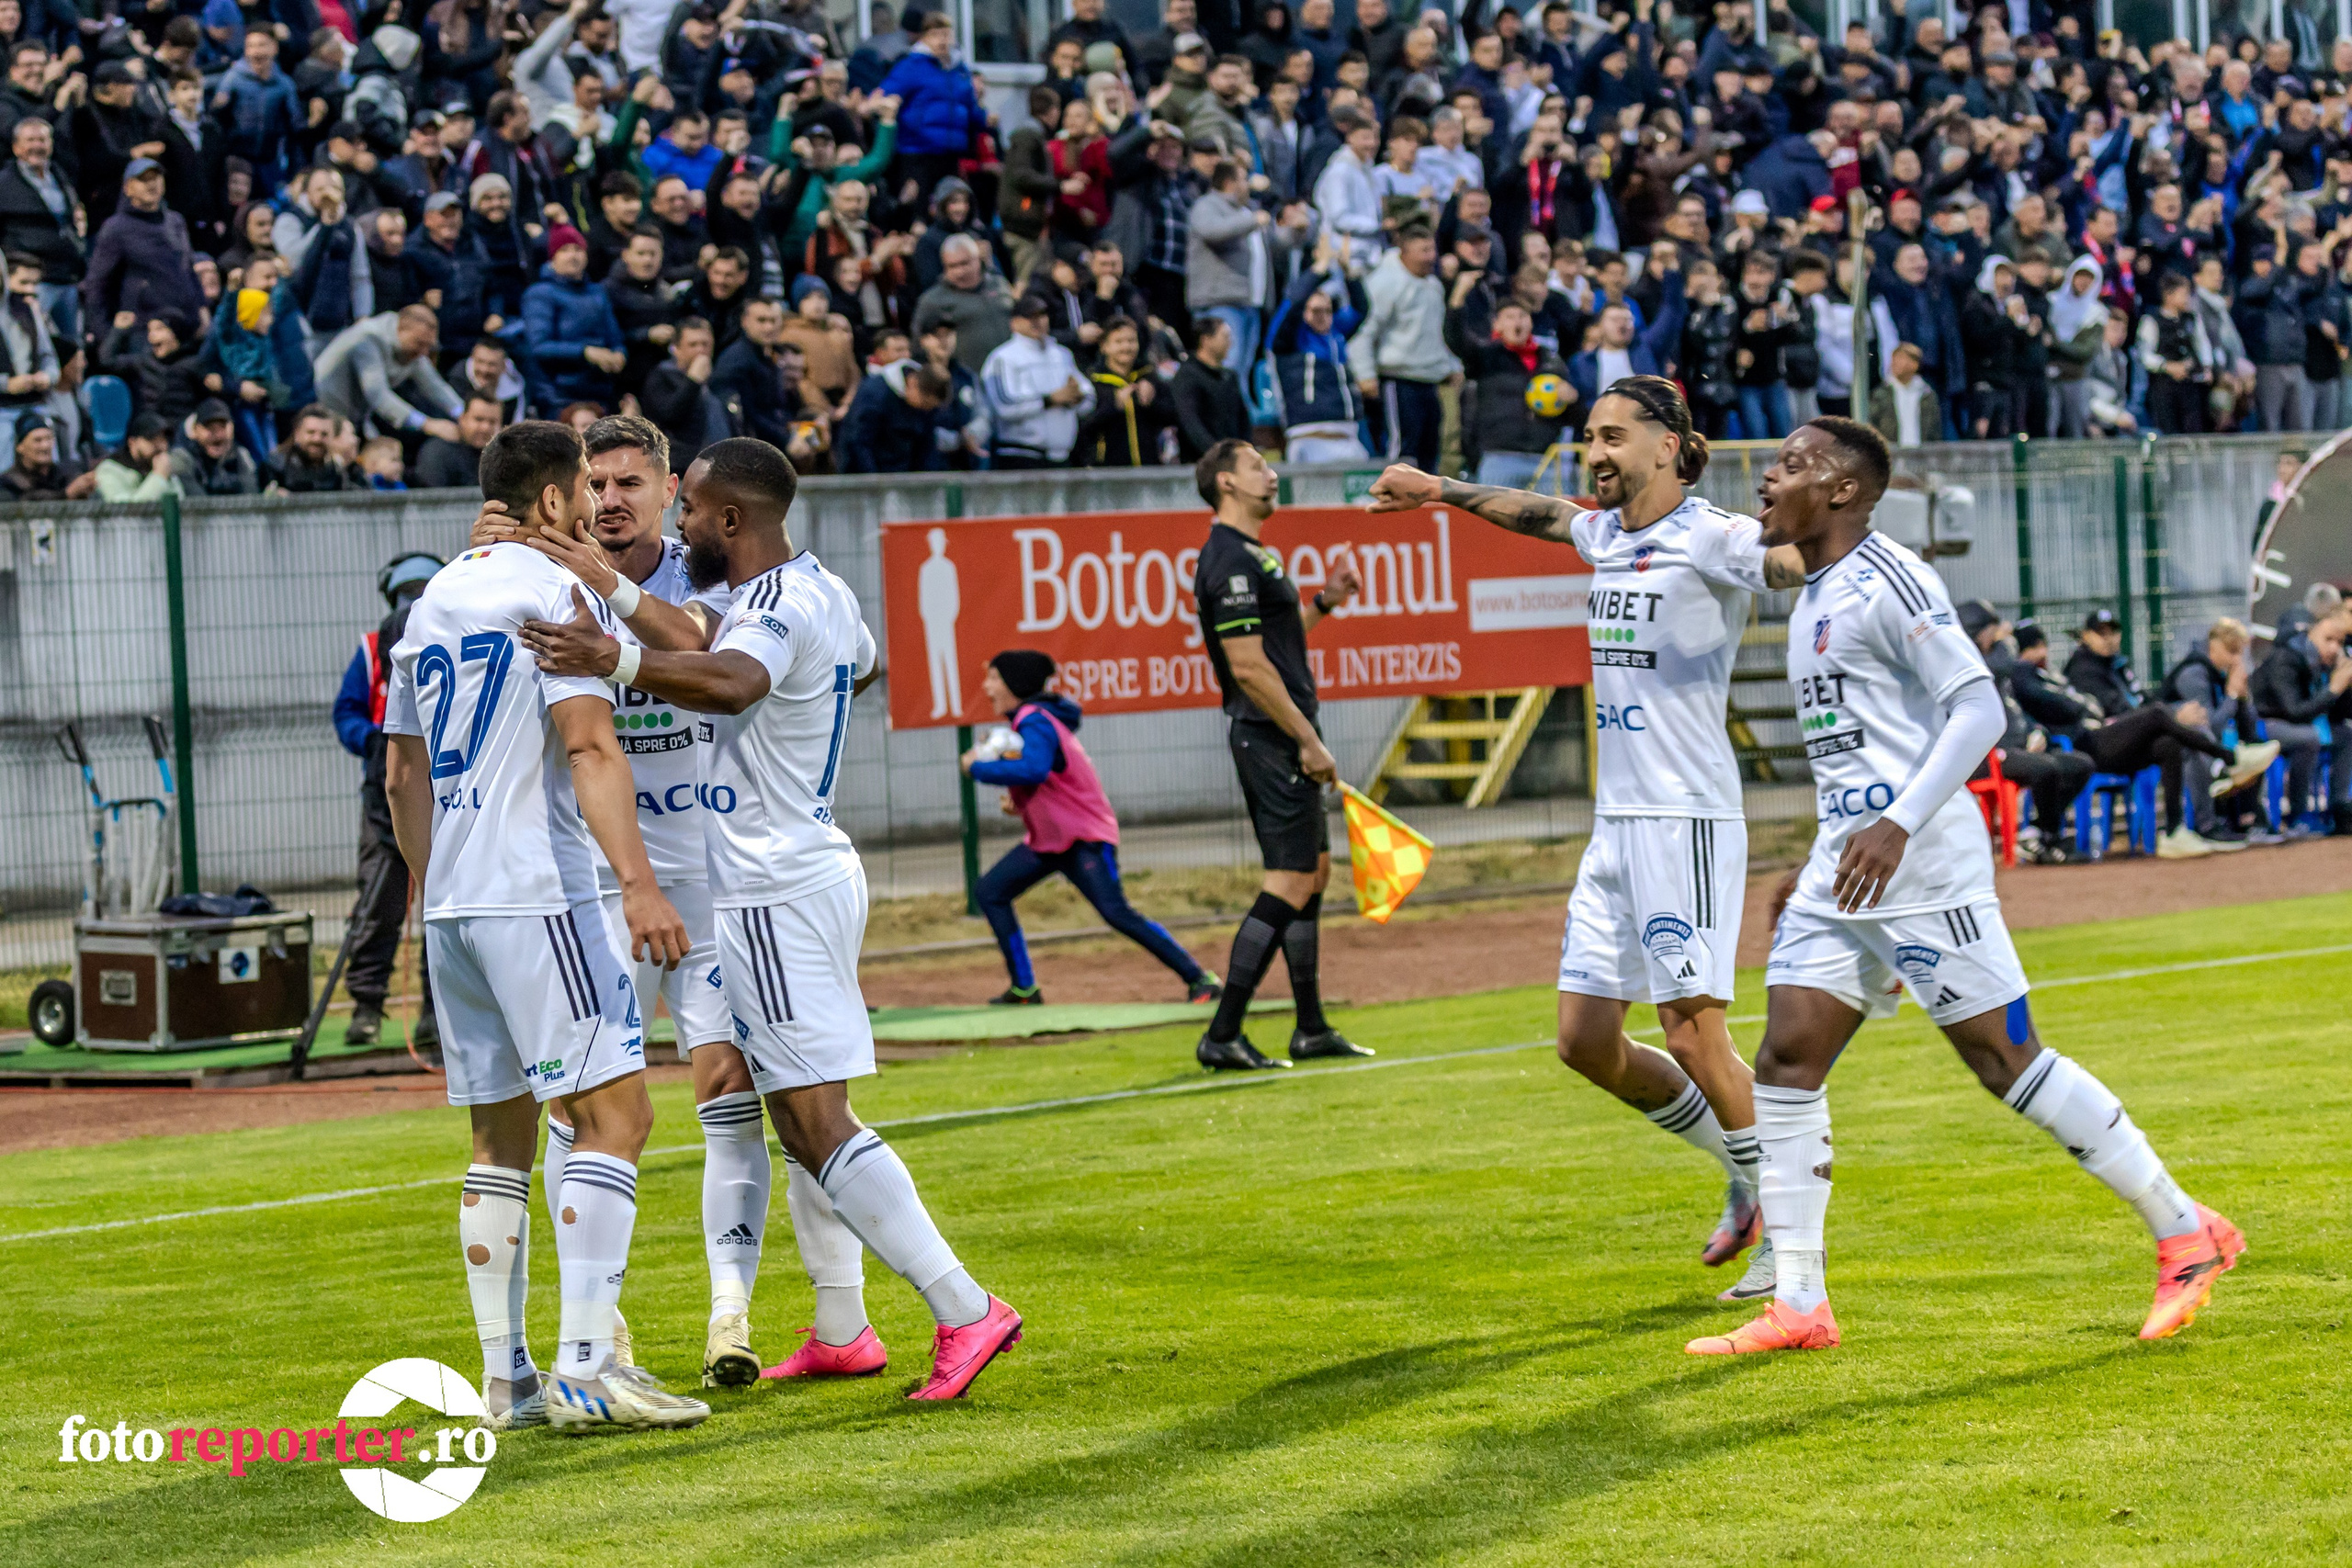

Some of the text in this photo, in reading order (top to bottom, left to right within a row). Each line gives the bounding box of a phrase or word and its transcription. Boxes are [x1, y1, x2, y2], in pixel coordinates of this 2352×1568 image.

[1339, 642, 1462, 687] INTERZIS
[417, 631, 514, 780] 27
[634, 739, 667, 752] SPRE
[669, 733, 689, 750] 0%
[538, 1058, 563, 1074] Eco
[544, 1069, 565, 1083] Plus
[717, 1235, 758, 1247] adidas
